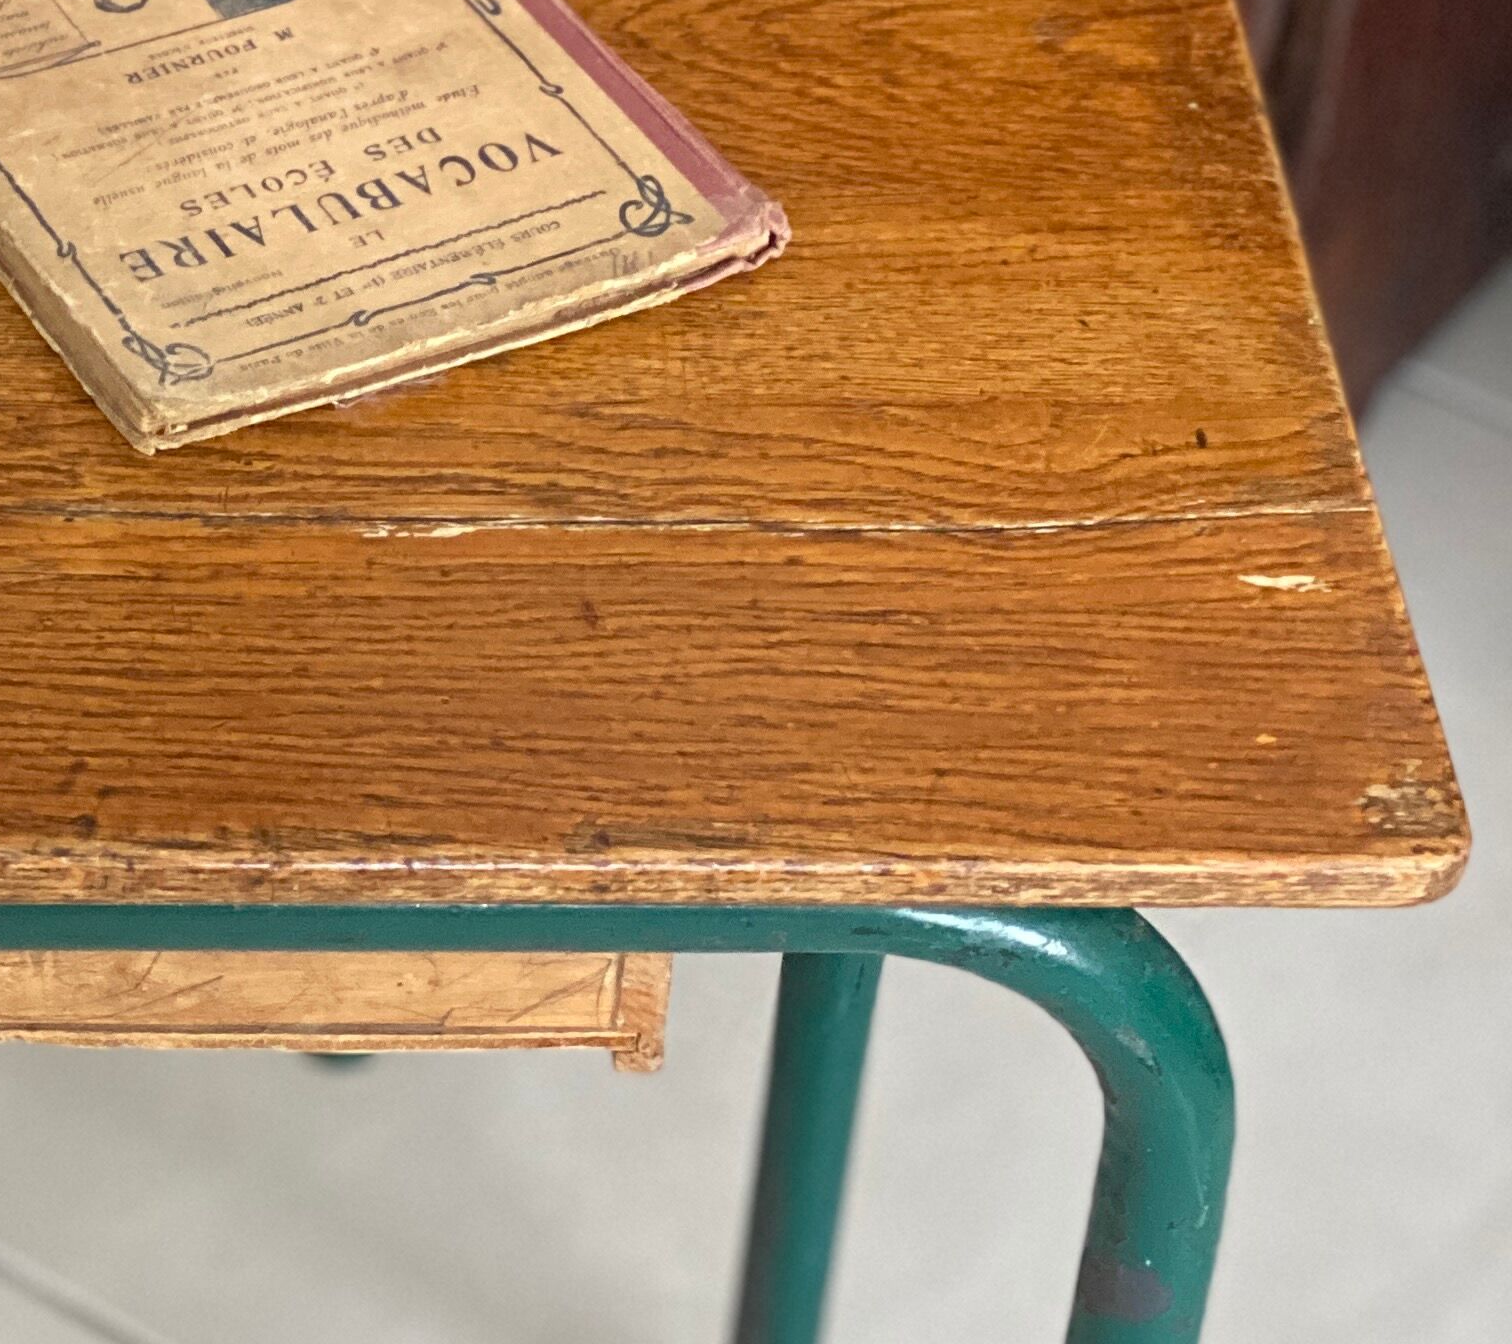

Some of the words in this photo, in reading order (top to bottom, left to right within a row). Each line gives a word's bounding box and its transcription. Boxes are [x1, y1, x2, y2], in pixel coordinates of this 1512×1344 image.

[122, 38, 259, 84] FOURNIER
[350, 87, 413, 114] d'après
[432, 82, 485, 106] Étude
[336, 99, 429, 136] méthodique
[238, 134, 260, 146] et
[260, 137, 304, 158] mots
[305, 128, 338, 145] des
[359, 124, 444, 163] DES
[213, 159, 235, 174] la
[235, 150, 262, 167] de
[150, 165, 211, 191] langue
[176, 158, 340, 220] ÉCOLES
[90, 183, 149, 211] usuelle
[115, 128, 564, 284] VOCABULAIRE
[346, 228, 386, 249] LE
[507, 219, 564, 243] COURS
[331, 285, 356, 300] ET
